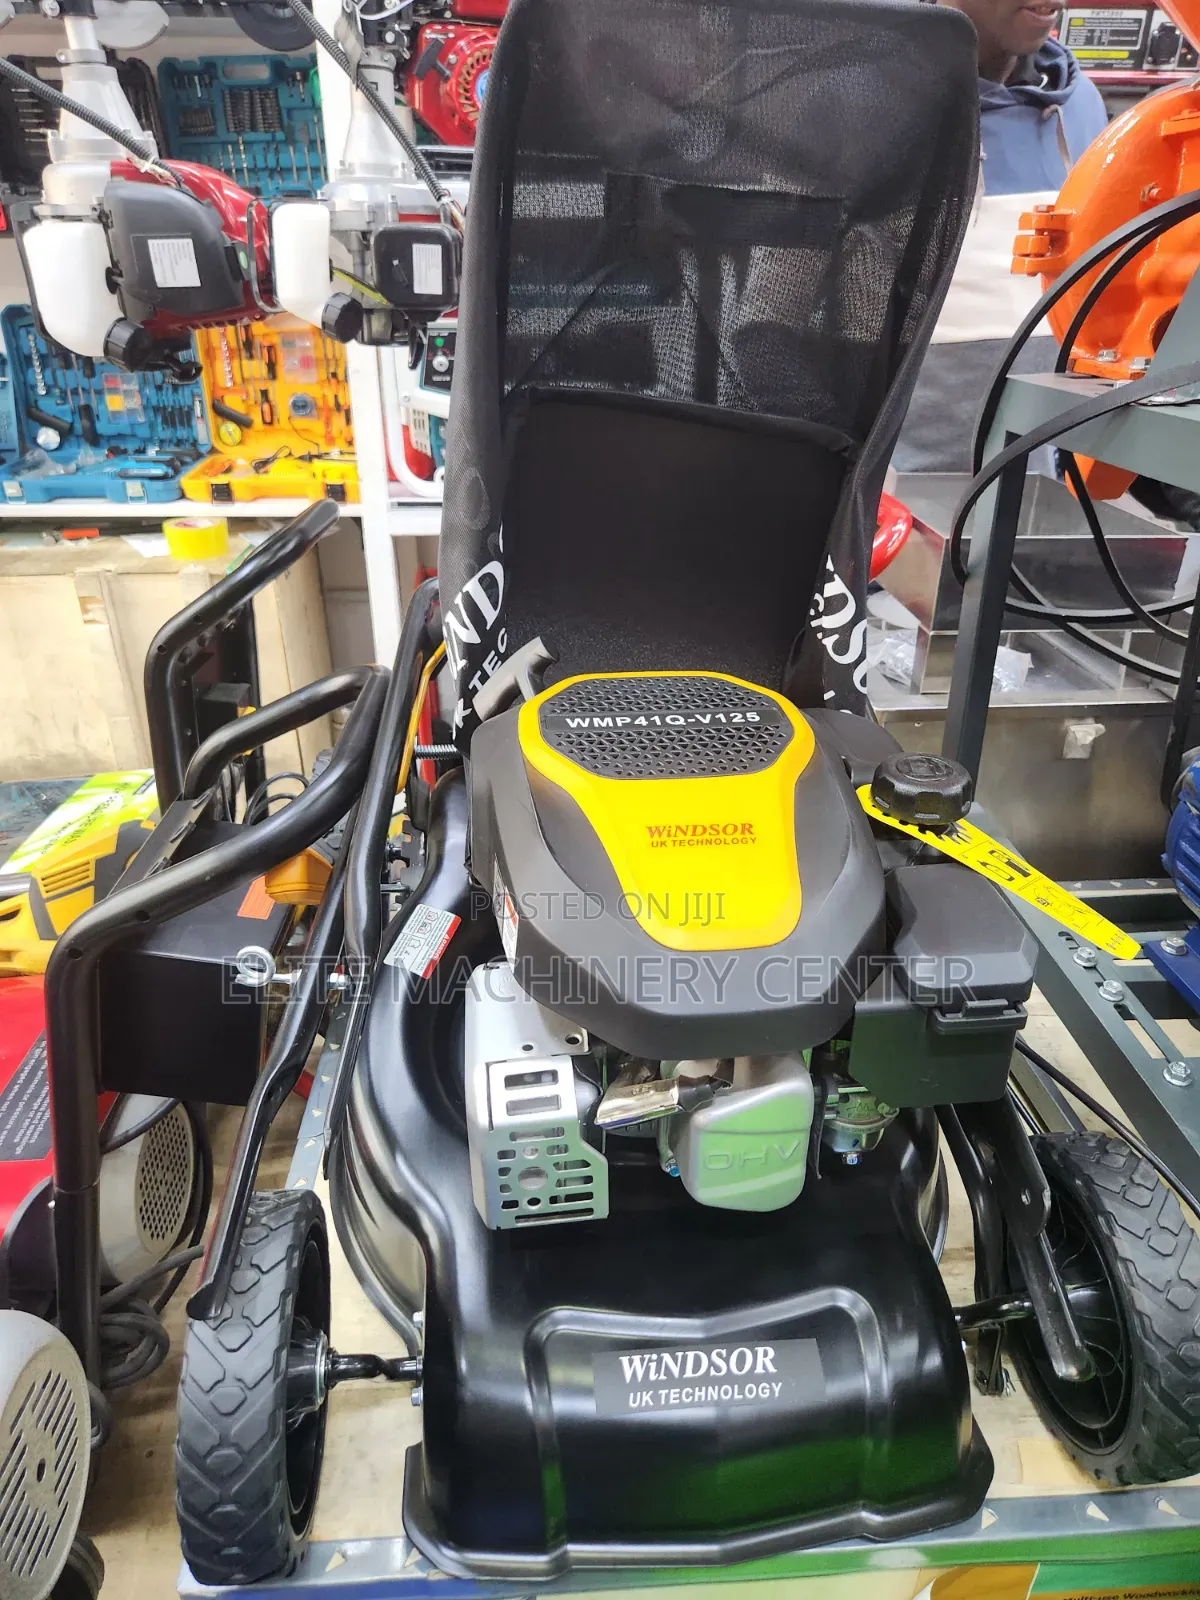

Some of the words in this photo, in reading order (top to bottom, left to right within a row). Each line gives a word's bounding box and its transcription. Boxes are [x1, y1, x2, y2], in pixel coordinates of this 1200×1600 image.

[565, 711, 761, 729] WMP41Q-V125
[651, 839, 668, 849] UK
[670, 836, 757, 848] TECHNOLOGY
[704, 1139, 801, 1171] OHV
[618, 1345, 778, 1384] WiNDSOR
[628, 1391, 655, 1408] UK
[658, 1382, 783, 1405] TECHNOLOGY
